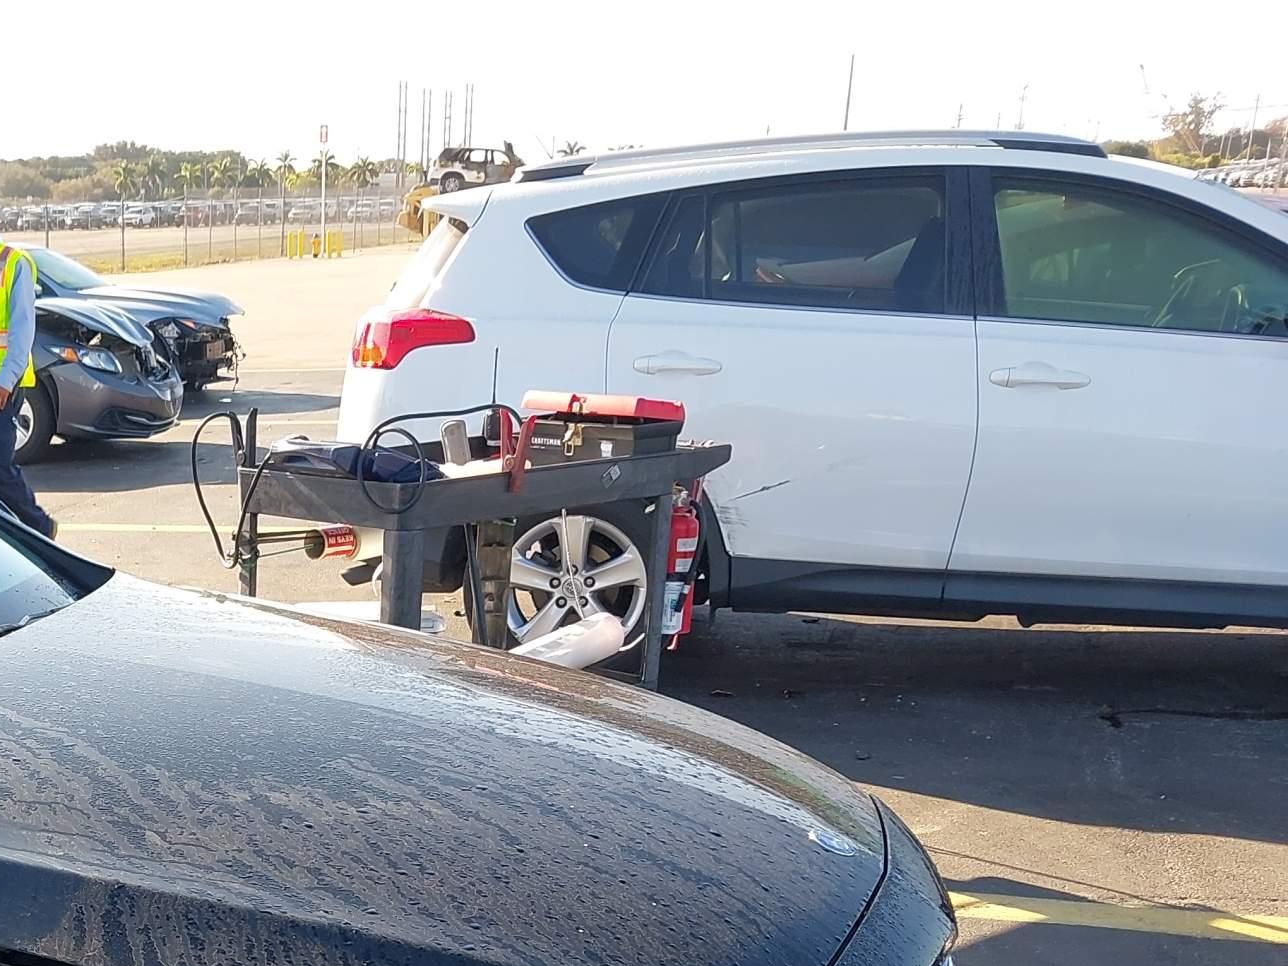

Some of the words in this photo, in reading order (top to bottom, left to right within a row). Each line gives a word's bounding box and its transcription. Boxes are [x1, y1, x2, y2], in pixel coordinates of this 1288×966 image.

[531, 436, 561, 446] CRAFTSMAN
[328, 537, 336, 545] IN
[337, 534, 354, 544] KEYS
